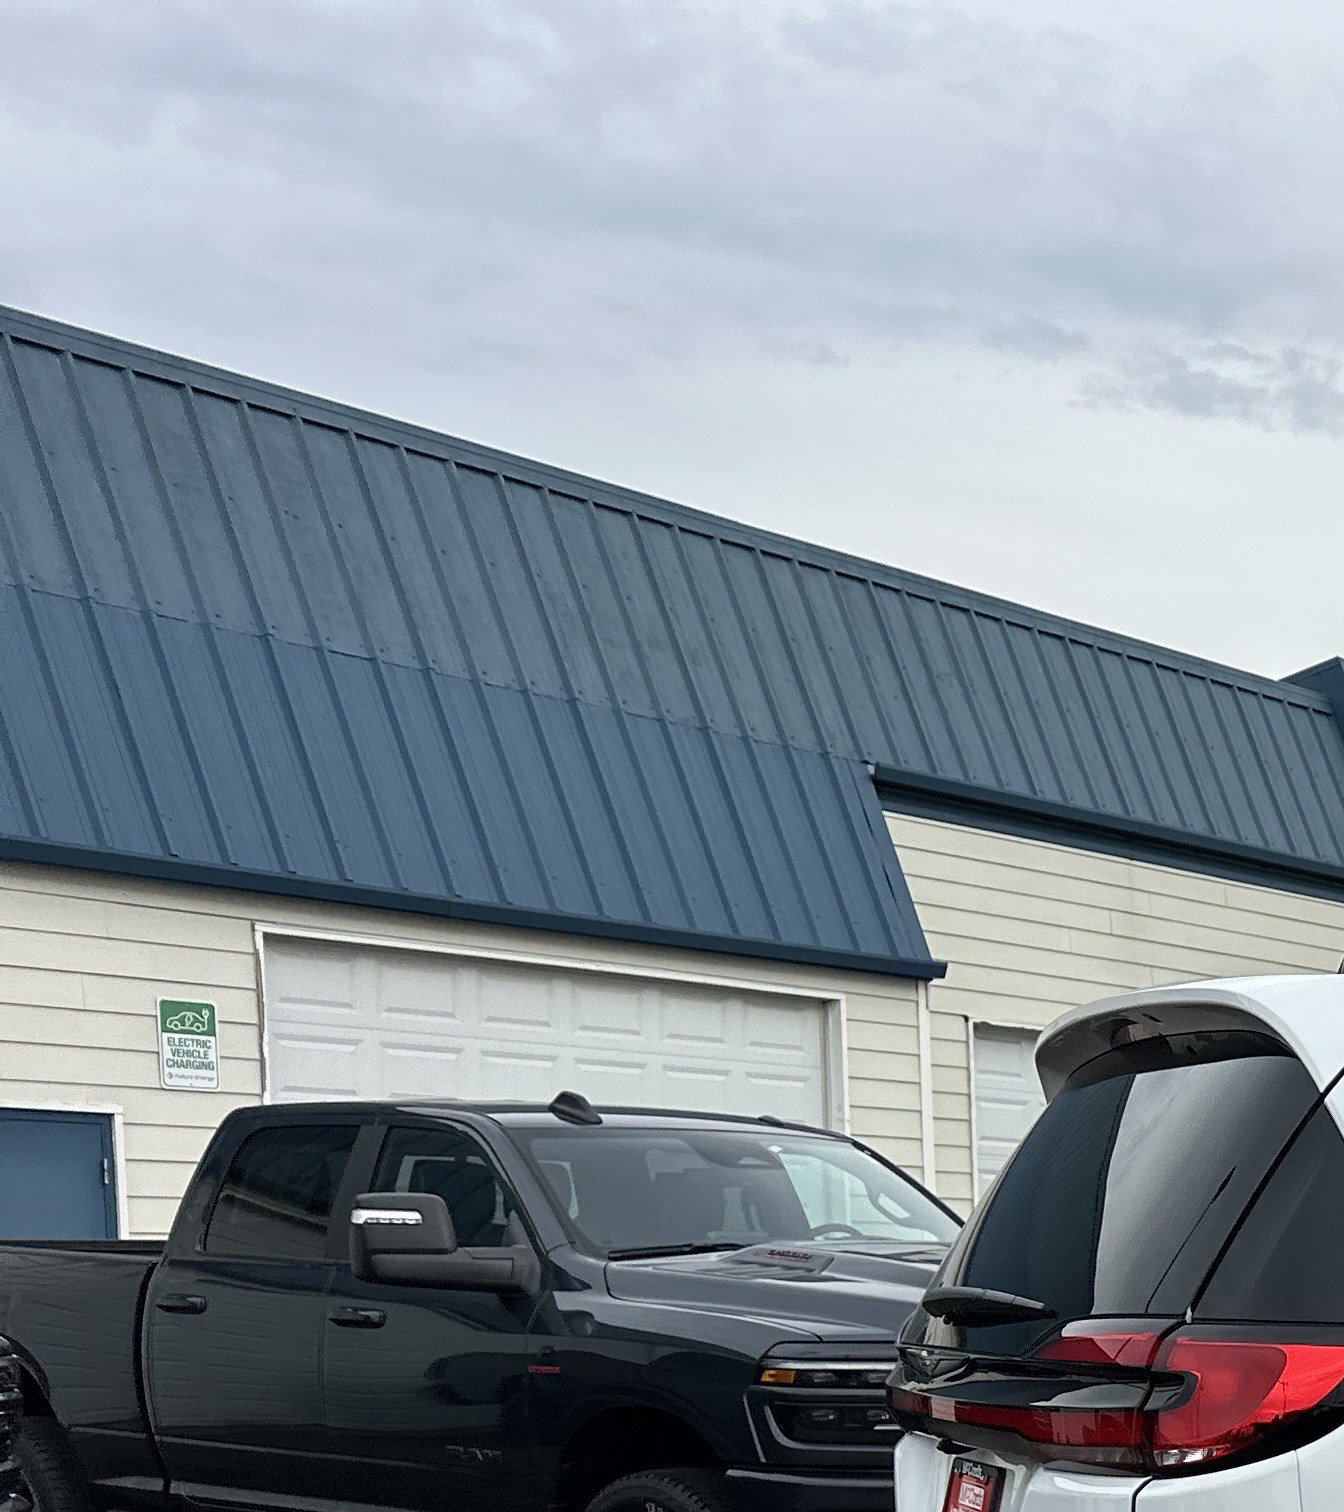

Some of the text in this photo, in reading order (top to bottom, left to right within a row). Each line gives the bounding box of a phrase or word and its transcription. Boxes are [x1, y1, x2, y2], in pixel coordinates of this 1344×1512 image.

[167, 1036, 212, 1049] ELECTRIC
[170, 1047, 209, 1060] VEHICLE
[166, 1058, 215, 1071] CHARGING
